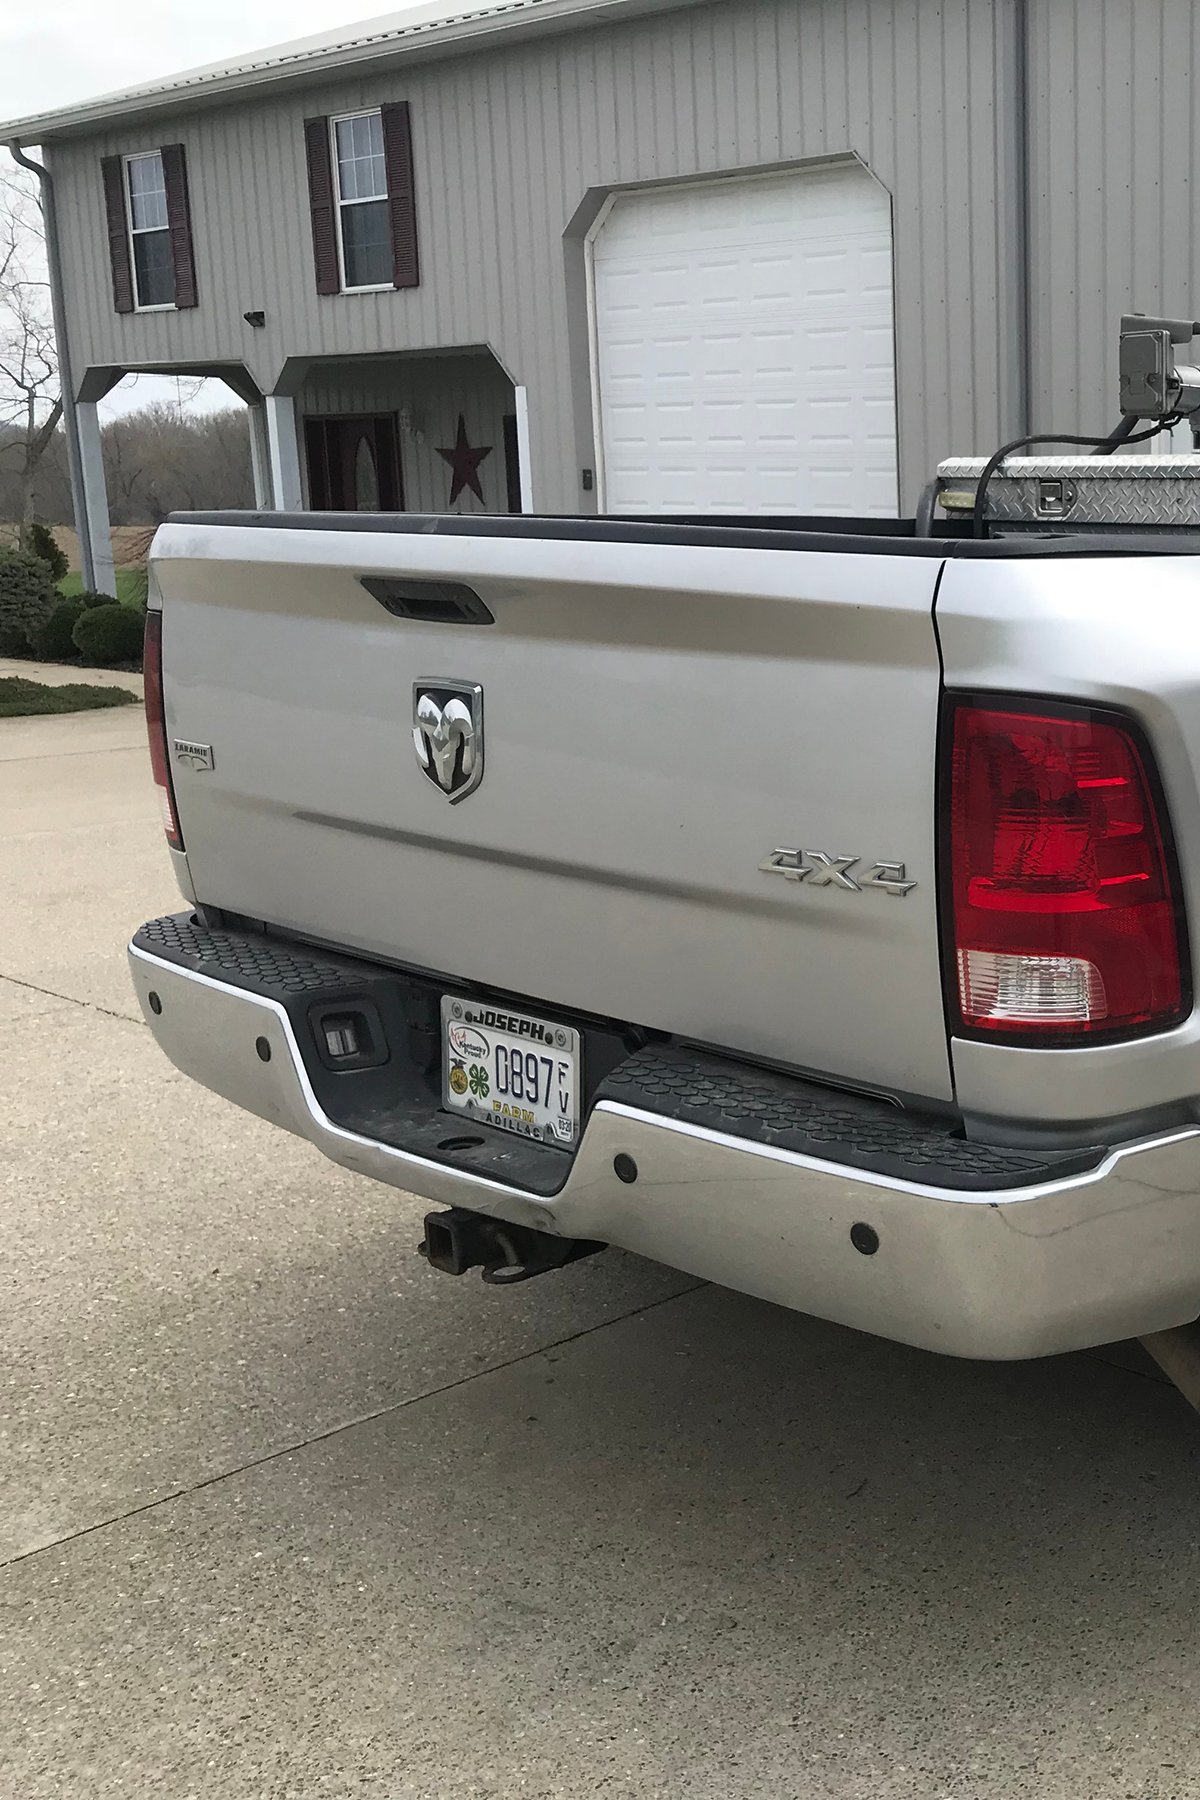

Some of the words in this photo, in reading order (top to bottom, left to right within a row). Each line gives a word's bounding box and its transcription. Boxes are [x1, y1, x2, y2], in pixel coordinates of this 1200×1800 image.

[175, 743, 208, 757] LARAMIE
[473, 1010, 544, 1040] JOSEPH
[459, 1041, 486, 1055] Kentucky
[492, 1100, 535, 1123] FARM
